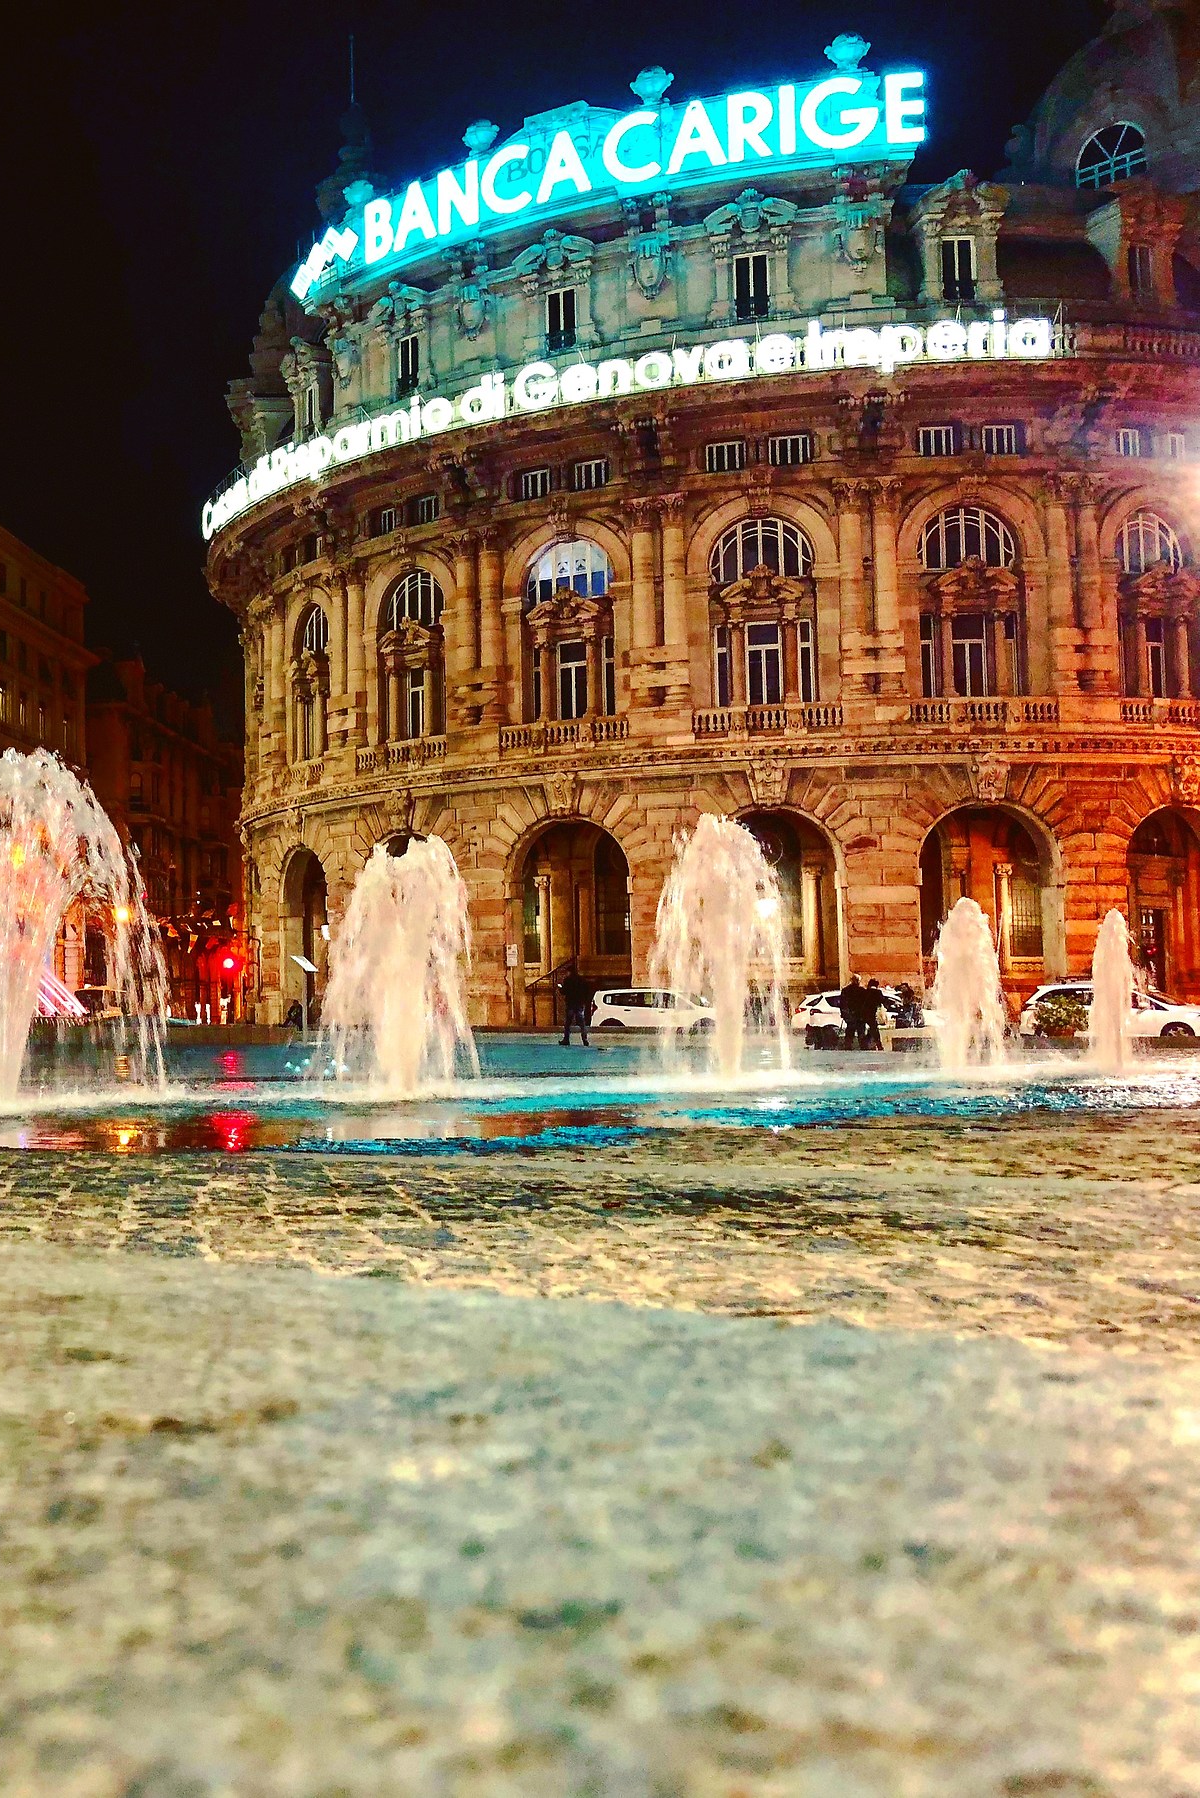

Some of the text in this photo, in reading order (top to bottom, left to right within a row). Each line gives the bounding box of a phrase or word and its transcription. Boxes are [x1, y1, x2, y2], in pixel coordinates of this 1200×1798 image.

[364, 72, 926, 265] BANCA CARIGE
[460, 371, 505, 419] di
[514, 338, 750, 410] Genova
[757, 333, 796, 373] e
[808, 308, 1051, 374] Imperia
